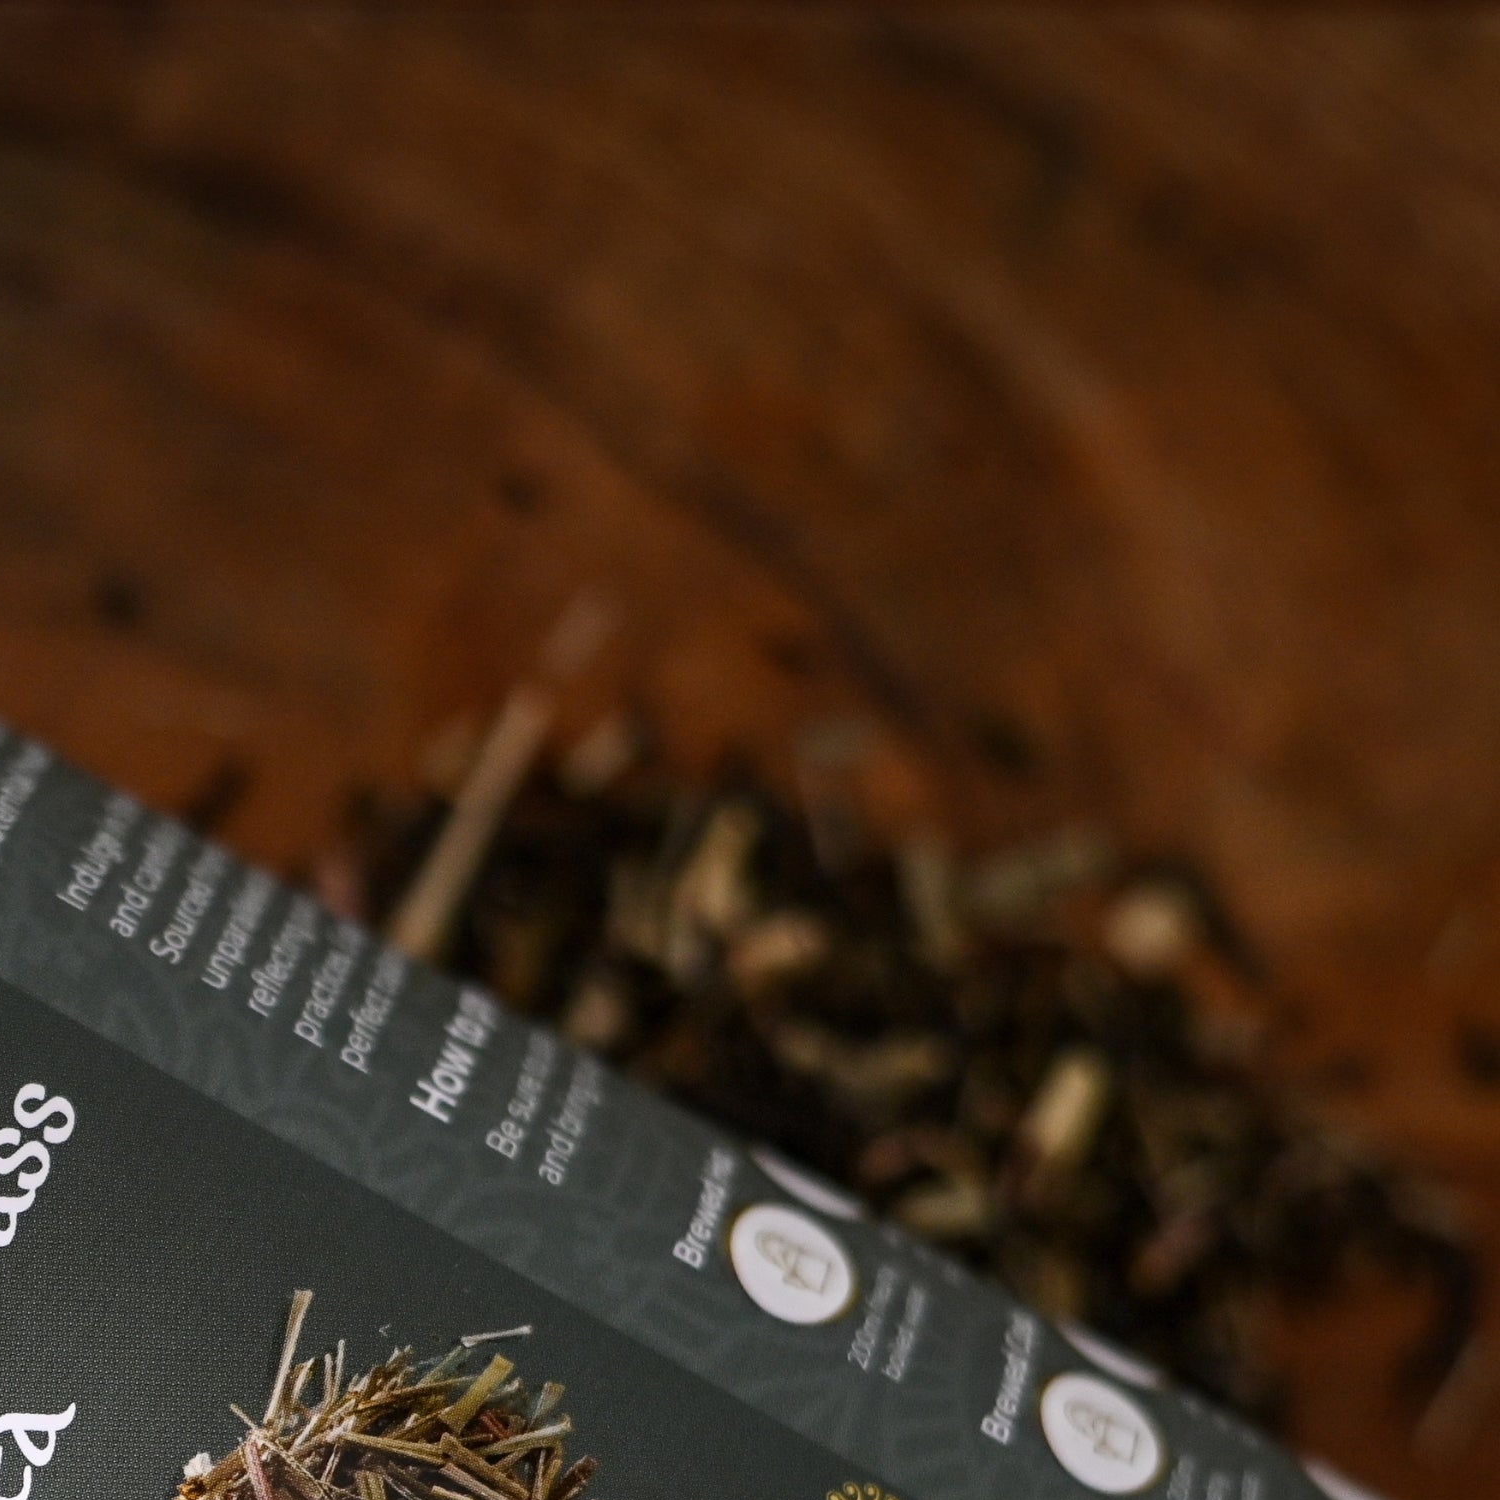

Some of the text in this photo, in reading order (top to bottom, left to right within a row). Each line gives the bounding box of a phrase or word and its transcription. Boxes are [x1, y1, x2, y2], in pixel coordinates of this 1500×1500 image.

[57, 832, 122, 911] Indulge
[110, 886, 149, 937] and
[150, 879, 212, 964] Sourced
[340, 989, 390, 1073] perfect
[410, 1043, 473, 1122] How
[486, 1121, 524, 1159] Be
[539, 1131, 575, 1185] and
[673, 1179, 726, 1268] Brewed
